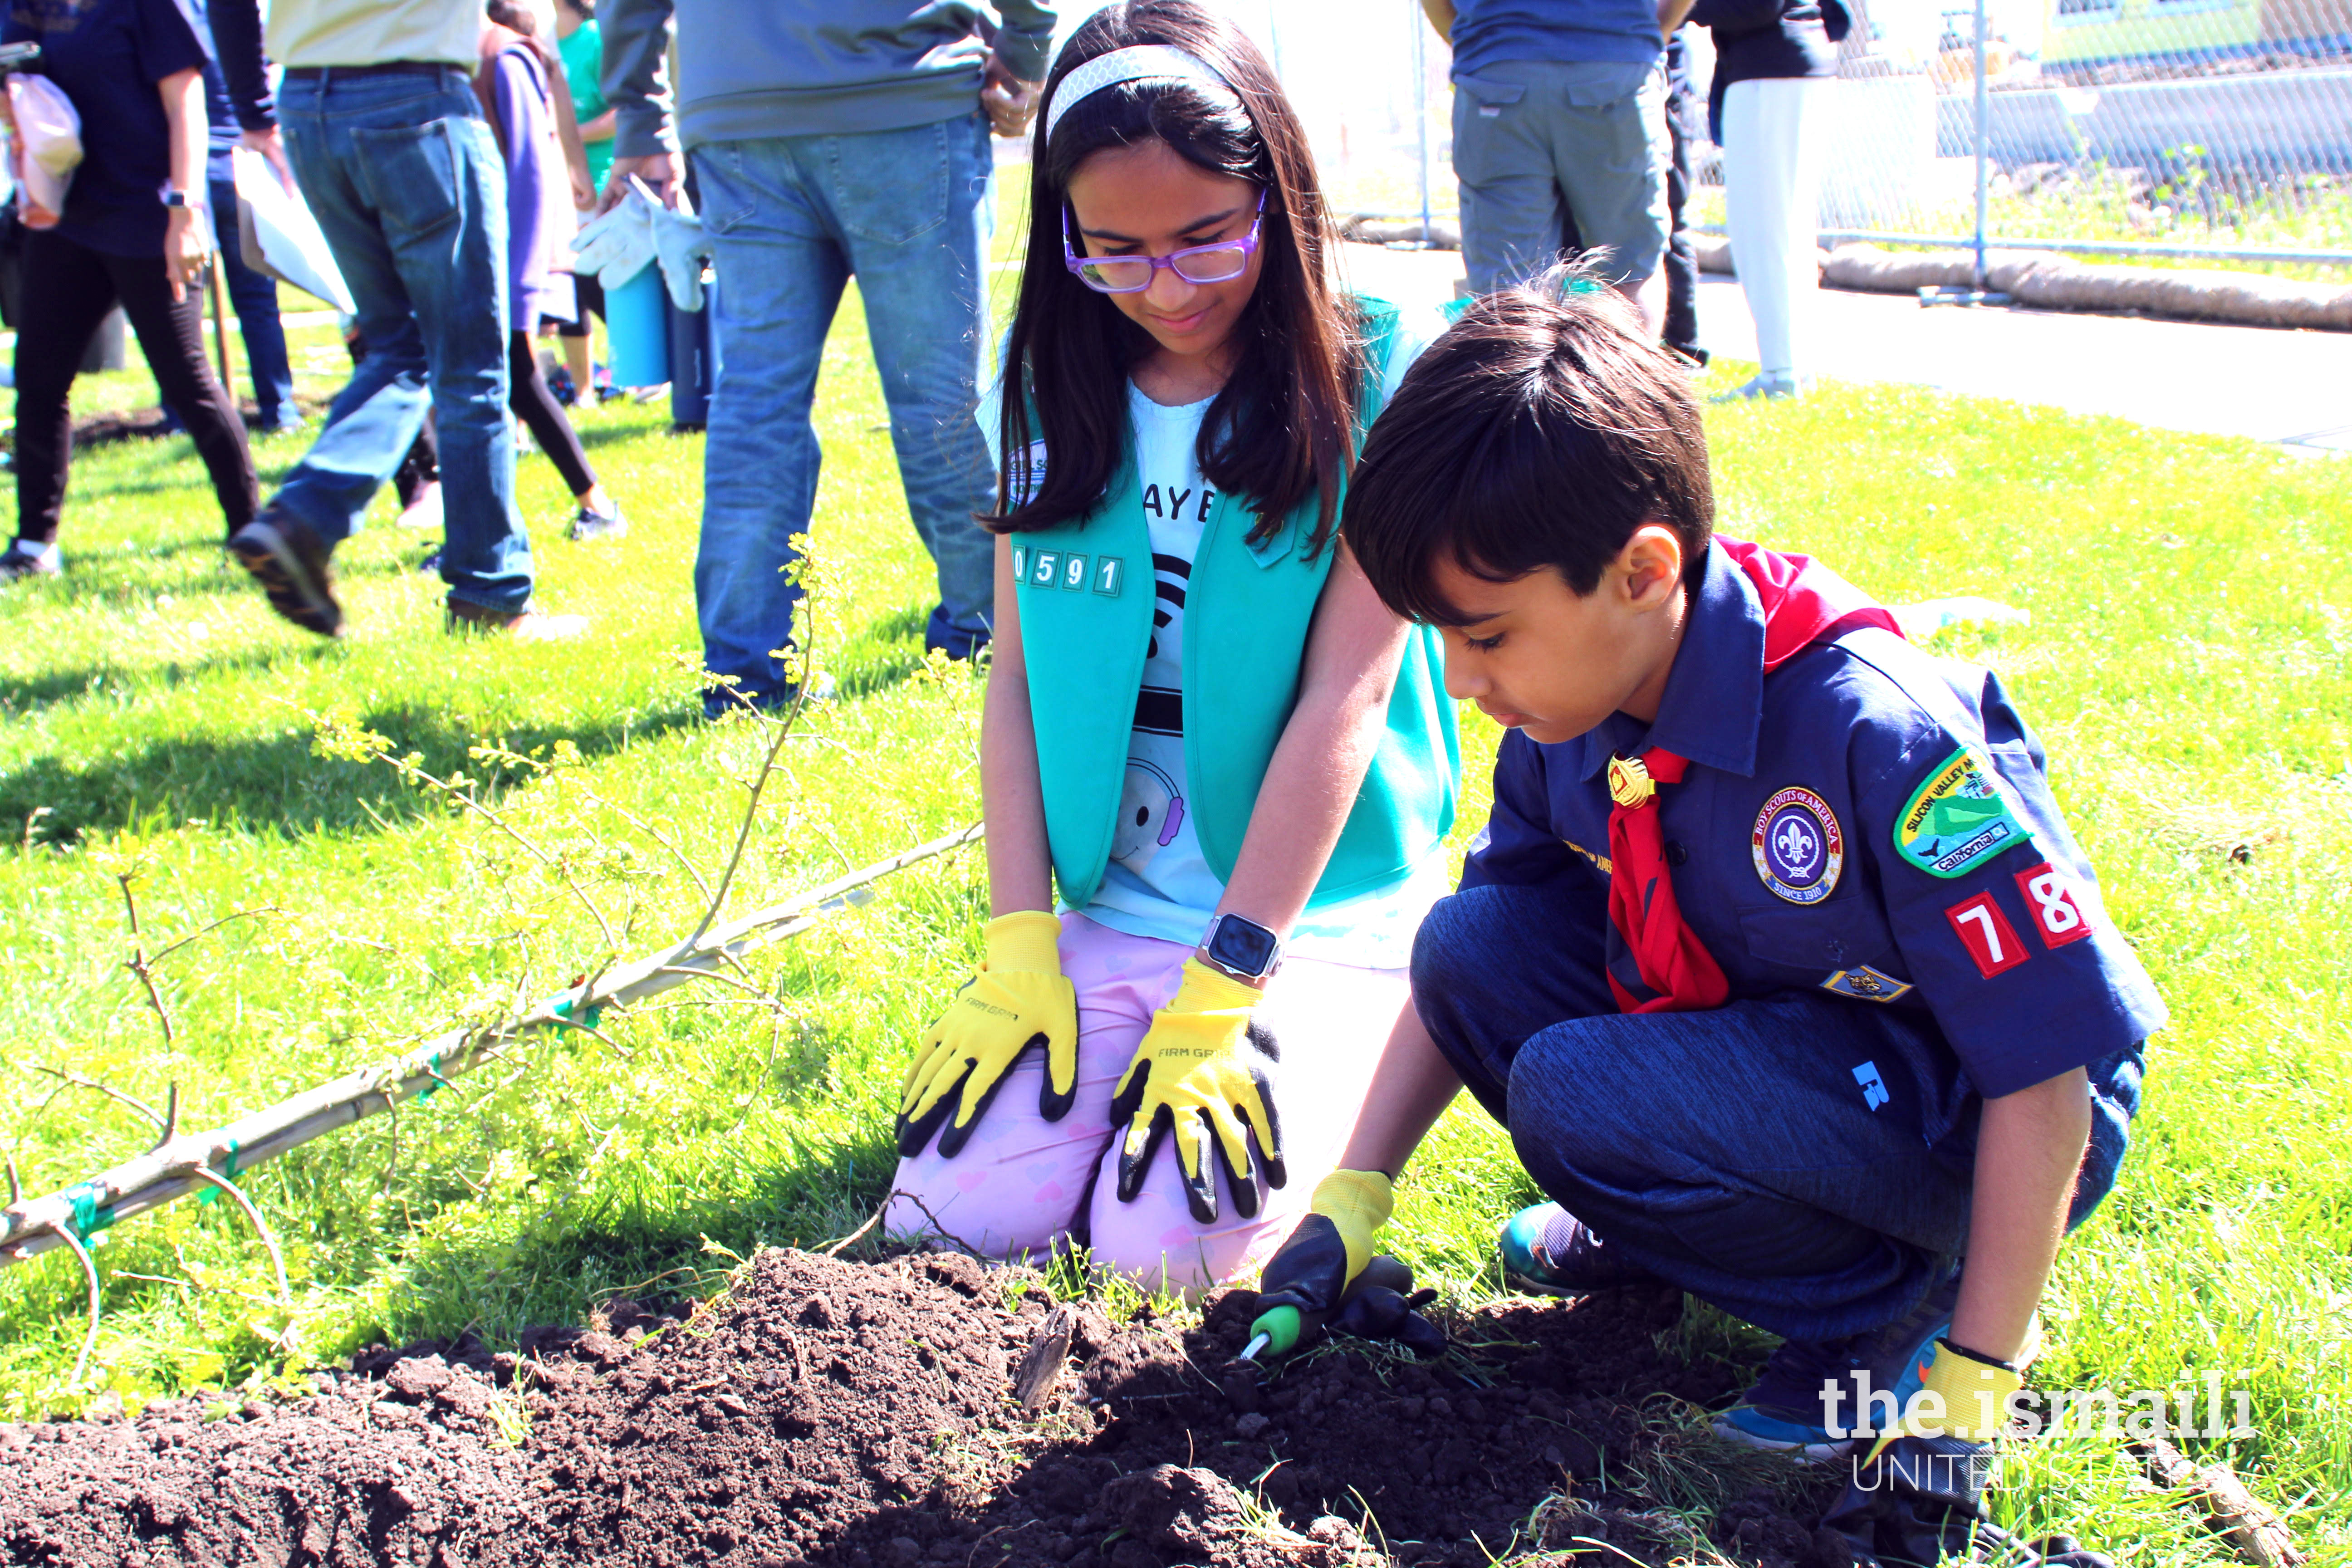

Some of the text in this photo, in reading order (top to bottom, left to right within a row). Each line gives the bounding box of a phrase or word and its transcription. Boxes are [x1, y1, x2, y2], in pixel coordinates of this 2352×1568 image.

[1754, 790, 1838, 844] BOY SCOUTS OF AMERICA
[1906, 795, 1936, 833] SILICON
[1933, 766, 1964, 797] VALLEY
[1938, 835, 1995, 870] California
[1774, 882, 1822, 901] SINCE 1910
[1158, 1048, 1190, 1058] FIRM
